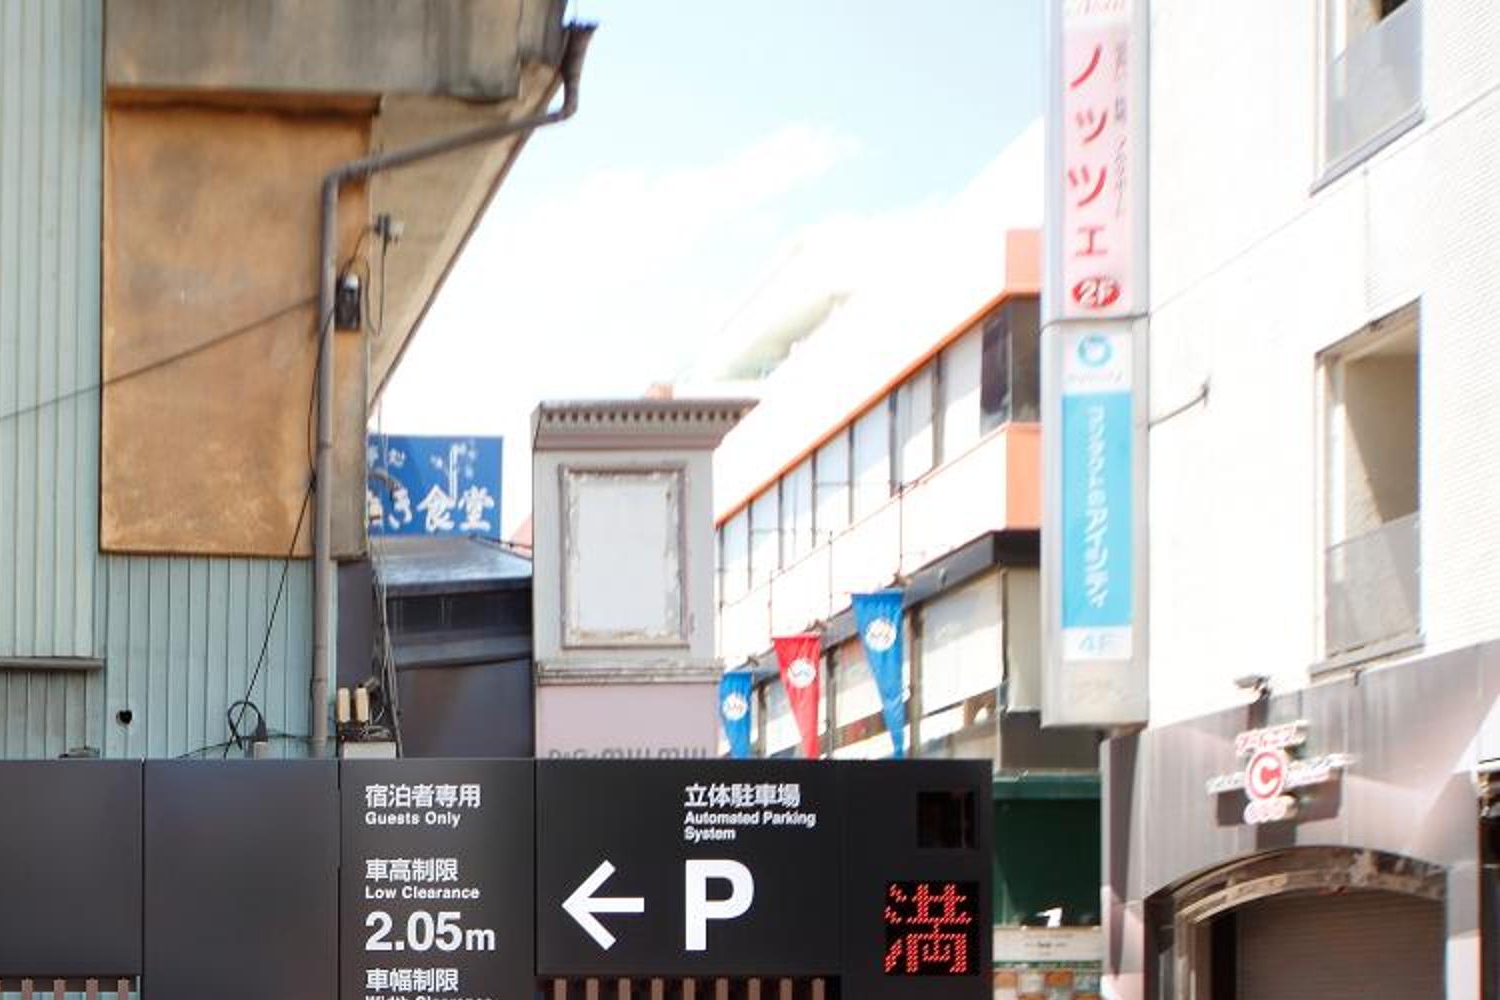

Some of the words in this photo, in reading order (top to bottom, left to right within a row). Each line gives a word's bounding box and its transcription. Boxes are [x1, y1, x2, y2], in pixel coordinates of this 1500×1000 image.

[365, 783, 481, 809] 宿泊者専用
[684, 783, 801, 808] 立体駐車場
[365, 811, 421, 826] Guests
[425, 811, 462, 829] Only
[684, 811, 760, 826] Automated
[763, 811, 817, 829] Parking
[684, 826, 736, 843] System
[365, 858, 459, 883] 車高制限
[365, 885, 398, 900] Low
[401, 885, 481, 900] Clearance
[685, 860, 755, 951] P
[365, 909, 496, 952] 2.05m
[884, 883, 973, 973] 満
[365, 968, 459, 993] 車幅制限
